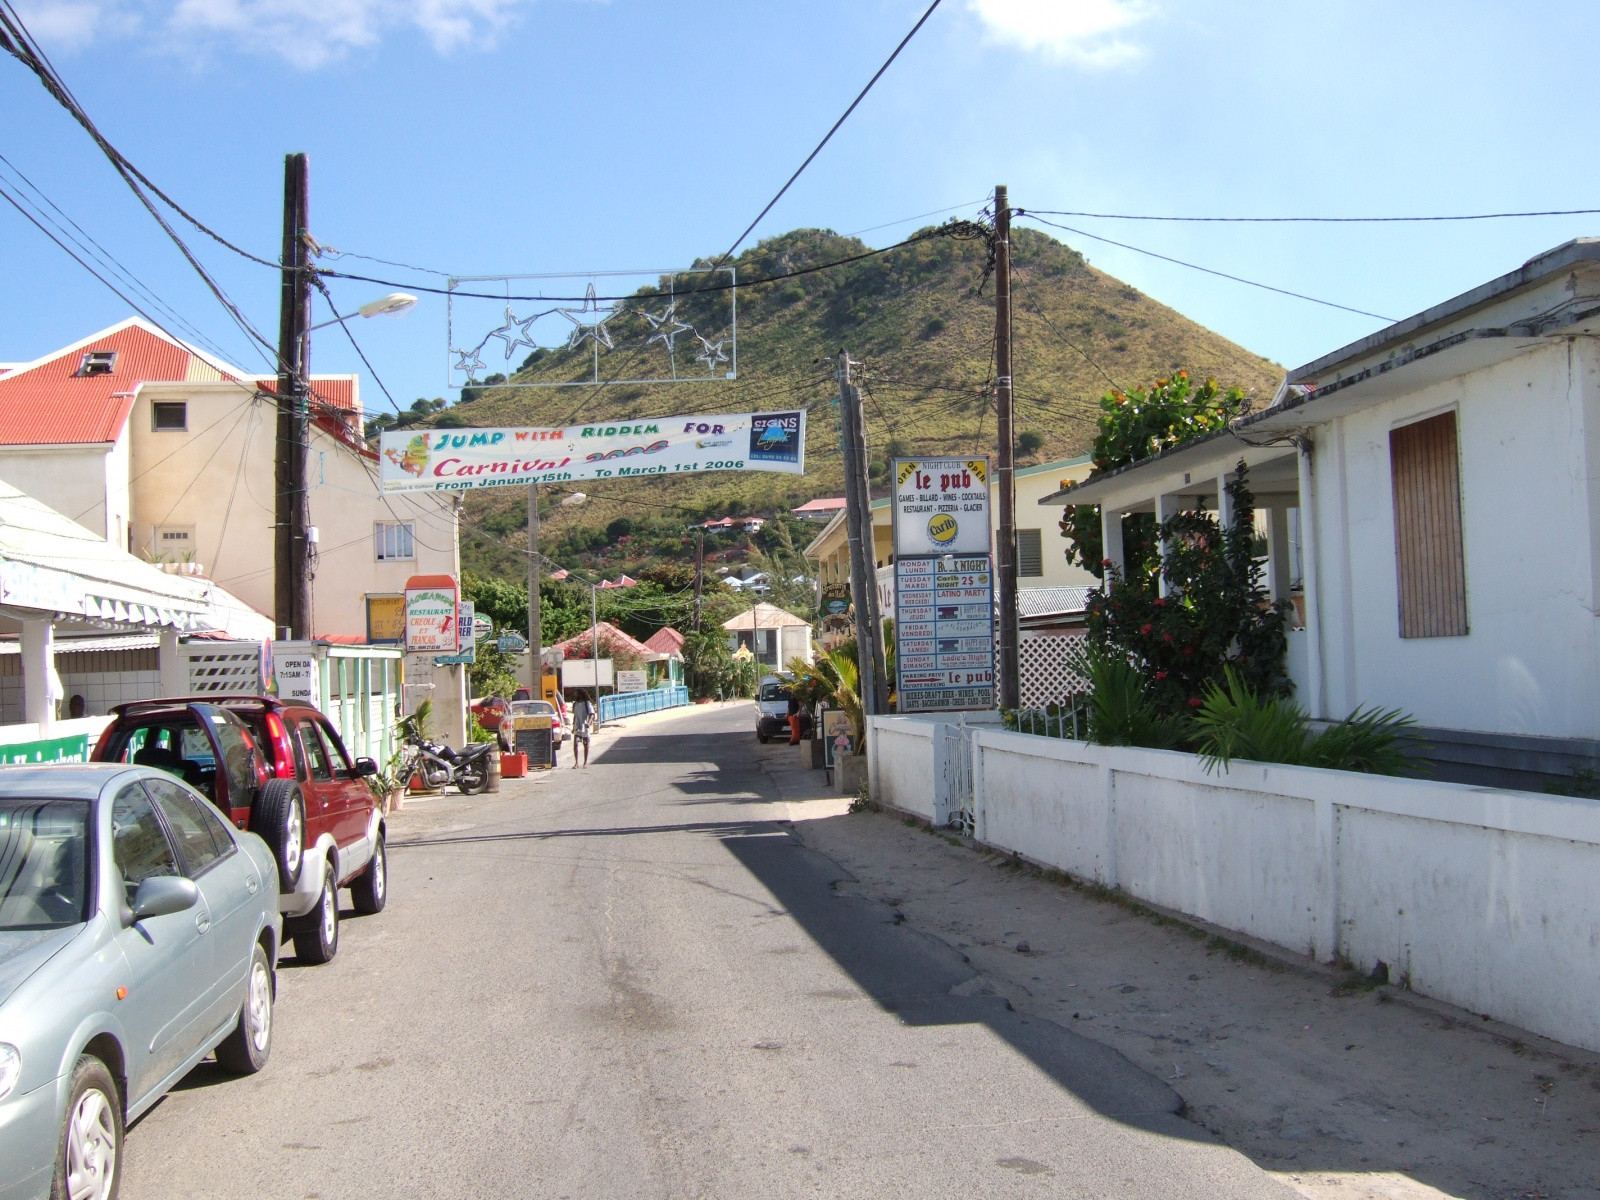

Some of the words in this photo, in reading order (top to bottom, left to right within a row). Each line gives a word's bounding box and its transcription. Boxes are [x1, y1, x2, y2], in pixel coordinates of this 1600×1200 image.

[754, 417, 797, 428] SIGNS
[434, 432, 505, 451] JUMP
[514, 429, 564, 441] WITH
[581, 424, 660, 438] RIDDEM
[683, 422, 725, 434] FOR
[433, 457, 571, 477] Carnival
[967, 461, 986, 482] OPEN
[435, 481, 473, 490] From
[595, 469, 612, 477] To
[618, 465, 667, 476] March
[674, 462, 698, 471] 1st
[704, 461, 744, 469] 2006
[898, 462, 916, 484] OPEN
[915, 470, 931, 490] le
[940, 469, 971, 493] pub
[898, 494, 915, 503] GAMES
[942, 493, 957, 501] WINES
[961, 492, 986, 501] COCKTAILS
[903, 504, 933, 514] RESTAURANT
[937, 504, 959, 513] PIZZERIA
[963, 503, 983, 512] GLACIER
[929, 519, 955, 536] Carib
[960, 559, 987, 571] NIGHT
[937, 590, 961, 598] LATINO
[964, 589, 986, 597] PARTY
[409, 608, 452, 616] RESTAURANT
[458, 616, 473, 627] RLD
[948, 671, 961, 684] le
[967, 670, 992, 685] pub
[291, 689, 311, 697] SUNDA
[958, 689, 975, 698] WINES
[977, 688, 991, 697] POOL
[906, 700, 920, 709] DARTS
